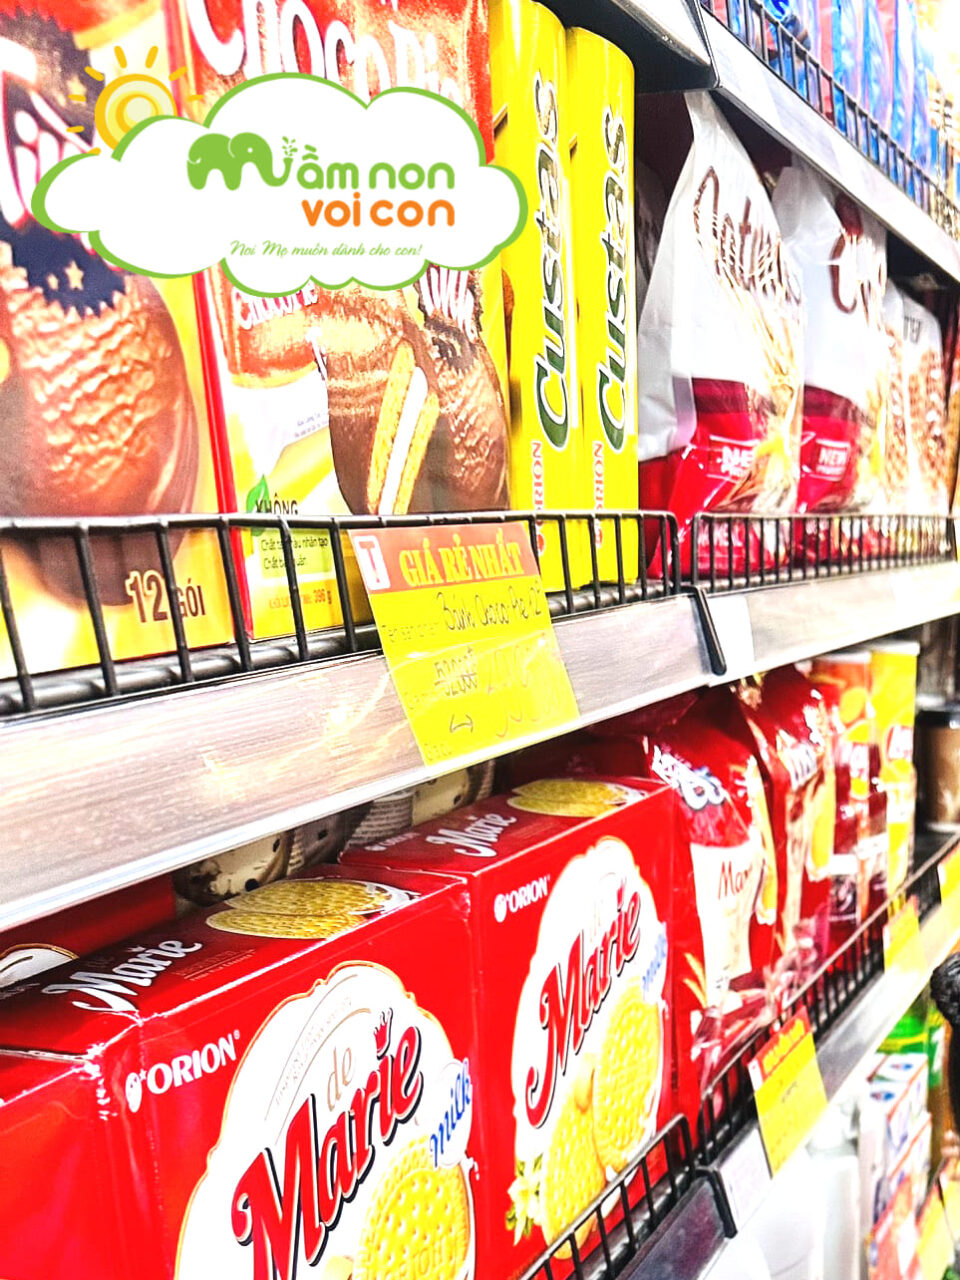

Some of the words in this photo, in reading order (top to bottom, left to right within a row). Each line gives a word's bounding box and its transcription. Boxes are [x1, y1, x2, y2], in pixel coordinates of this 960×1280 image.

[534, 69, 571, 452] Custas
[597, 104, 628, 453] Custas
[399, 537, 441, 588] GIÁ
[469, 527, 525, 579] NHẤT
[125, 570, 169, 623] 12
[426, 814, 517, 857] Marie
[508, 878, 548, 913] ORION
[42, 940, 203, 1012] Marie
[526, 890, 641, 1129] Marie
[147, 1034, 237, 1095] ORION
[328, 1046, 352, 1112] de
[430, 1059, 473, 1168] milk
